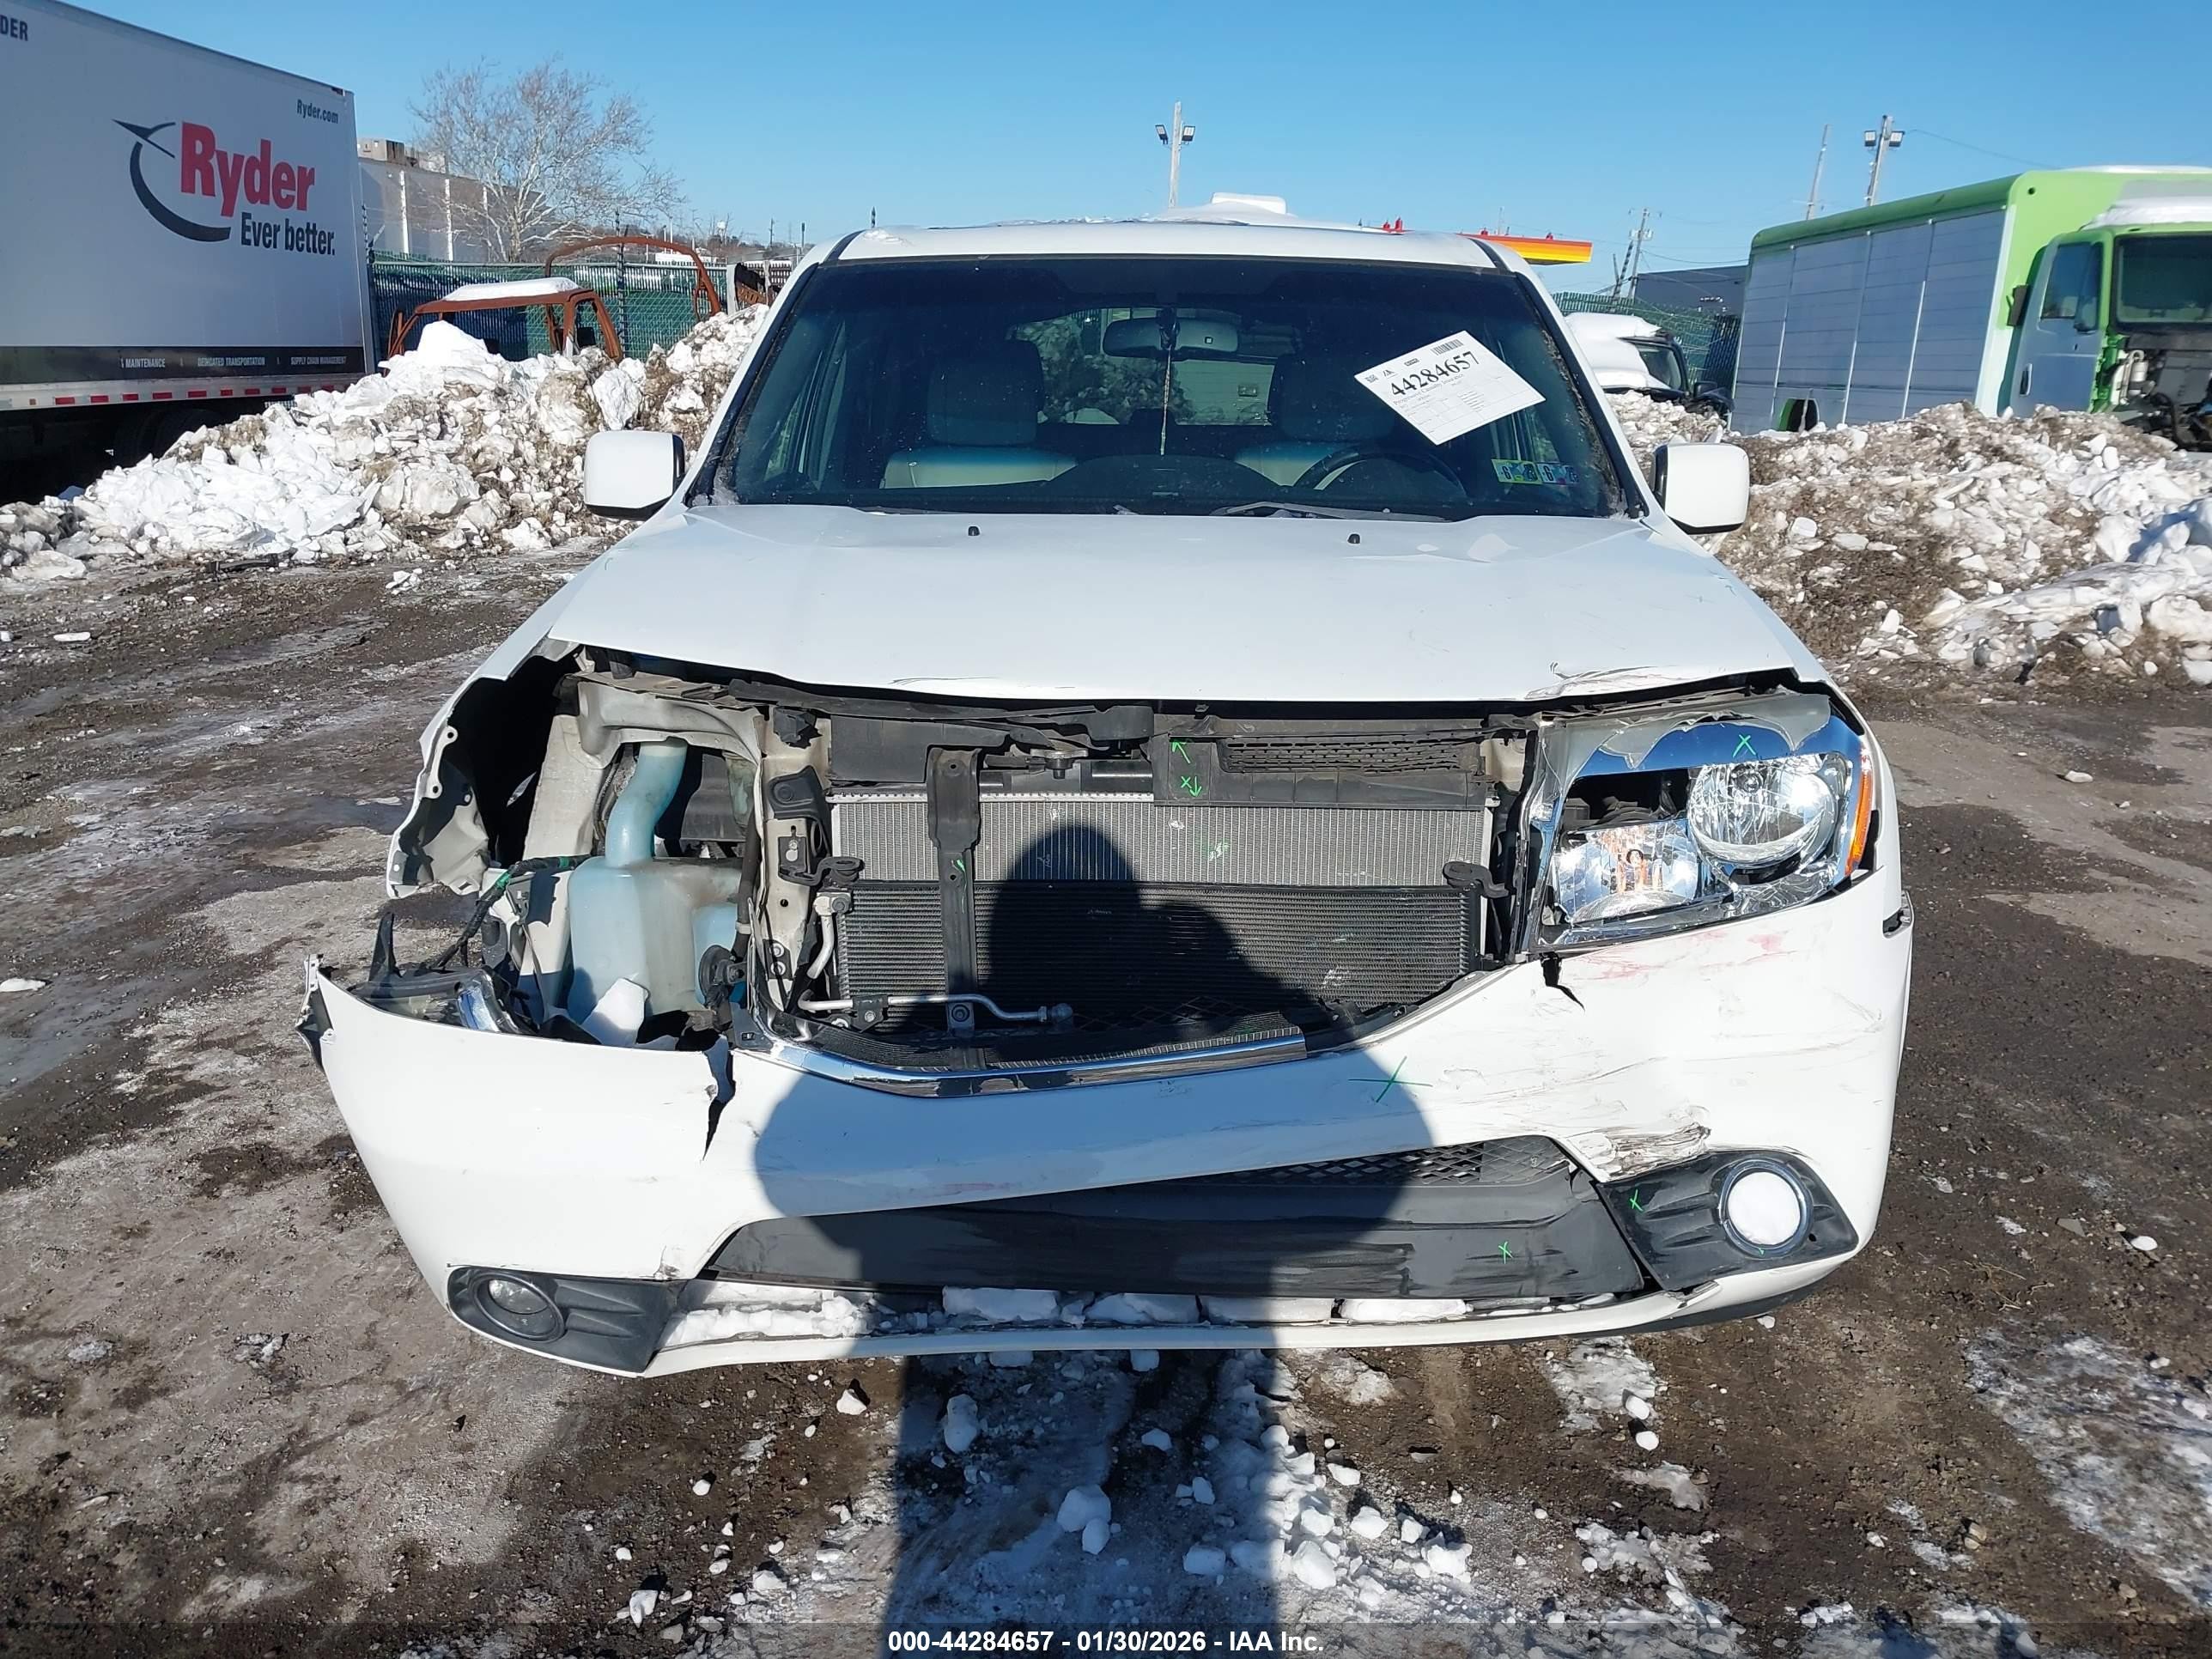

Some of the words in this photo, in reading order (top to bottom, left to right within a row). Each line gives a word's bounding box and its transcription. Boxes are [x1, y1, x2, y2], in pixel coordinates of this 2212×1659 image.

[296, 99, 338, 124] Ryder.com
[180, 121, 316, 217] Ryder
[240, 212, 282, 250] Ever
[284, 217, 337, 256] better.
[125, 357, 166, 368] MAINTENANCE
[197, 356, 225, 367] DEDICATED
[225, 356, 265, 367] TRANSPORTATION
[1390, 350, 1480, 397] 44284657
